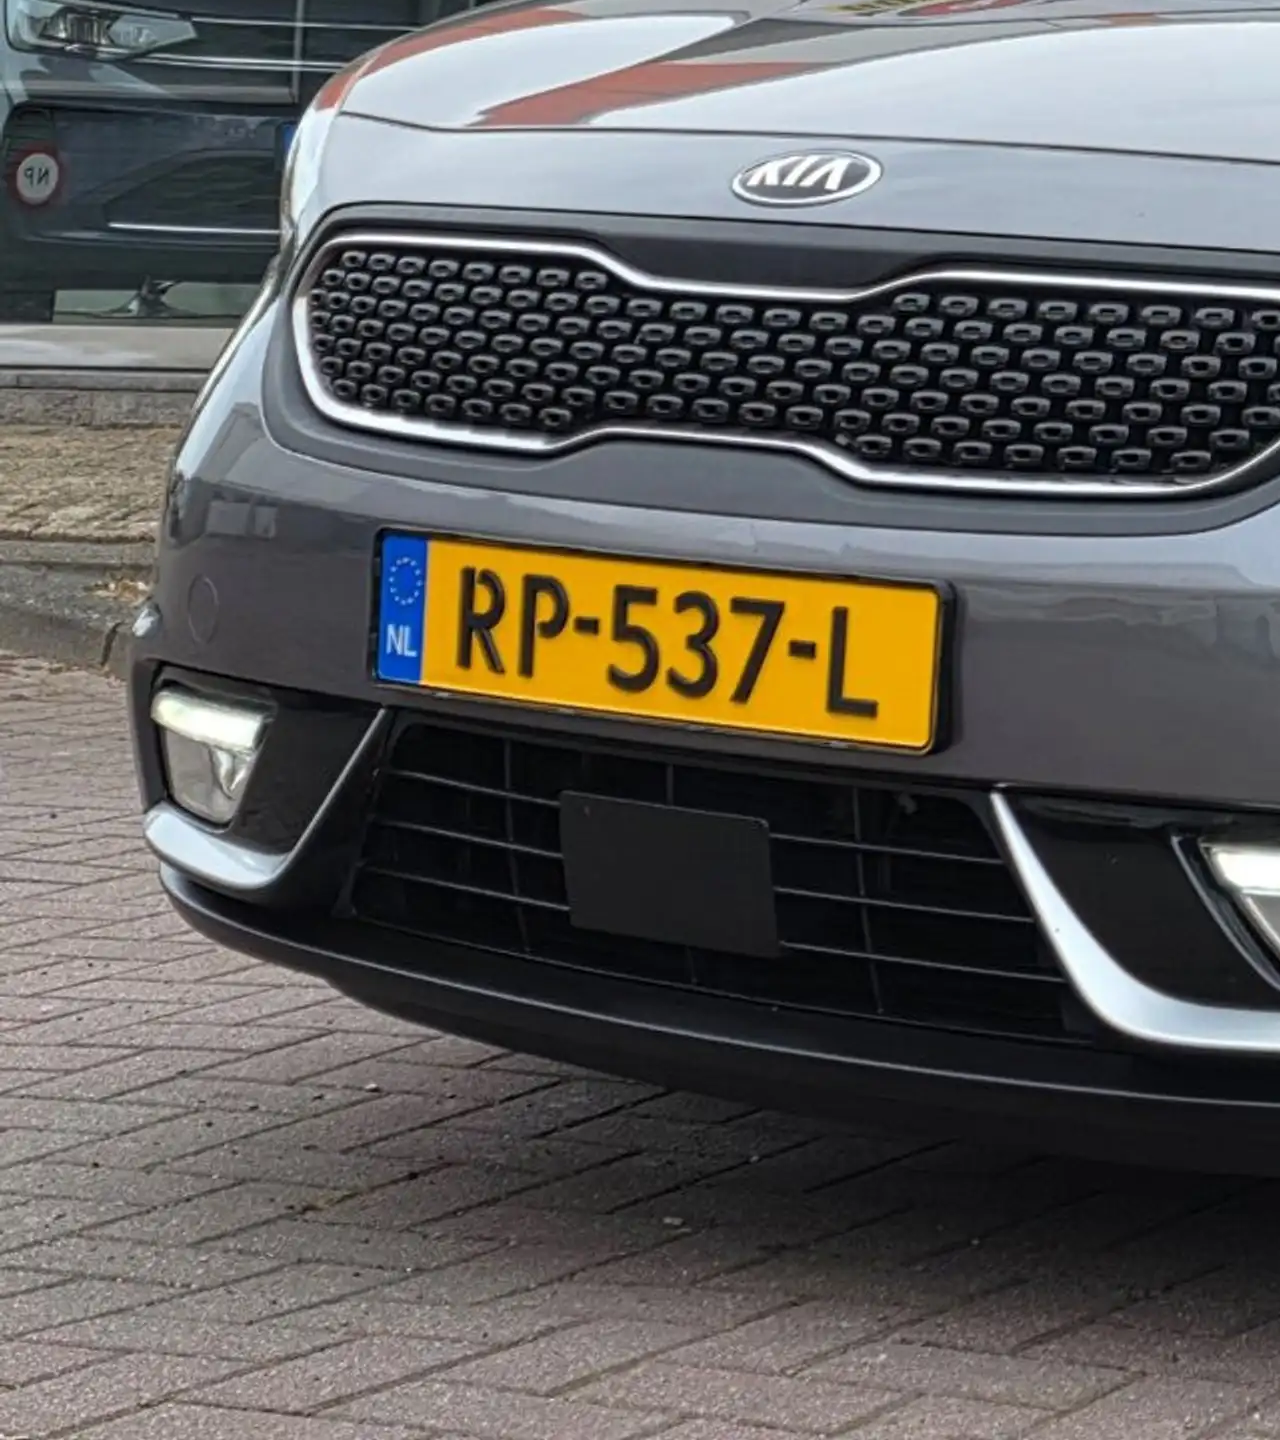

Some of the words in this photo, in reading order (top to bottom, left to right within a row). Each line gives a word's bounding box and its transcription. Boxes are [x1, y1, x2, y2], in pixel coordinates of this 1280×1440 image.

[745, 155, 853, 192] KIA
[386, 624, 418, 658] NL
[456, 567, 879, 720] RP-537-L
